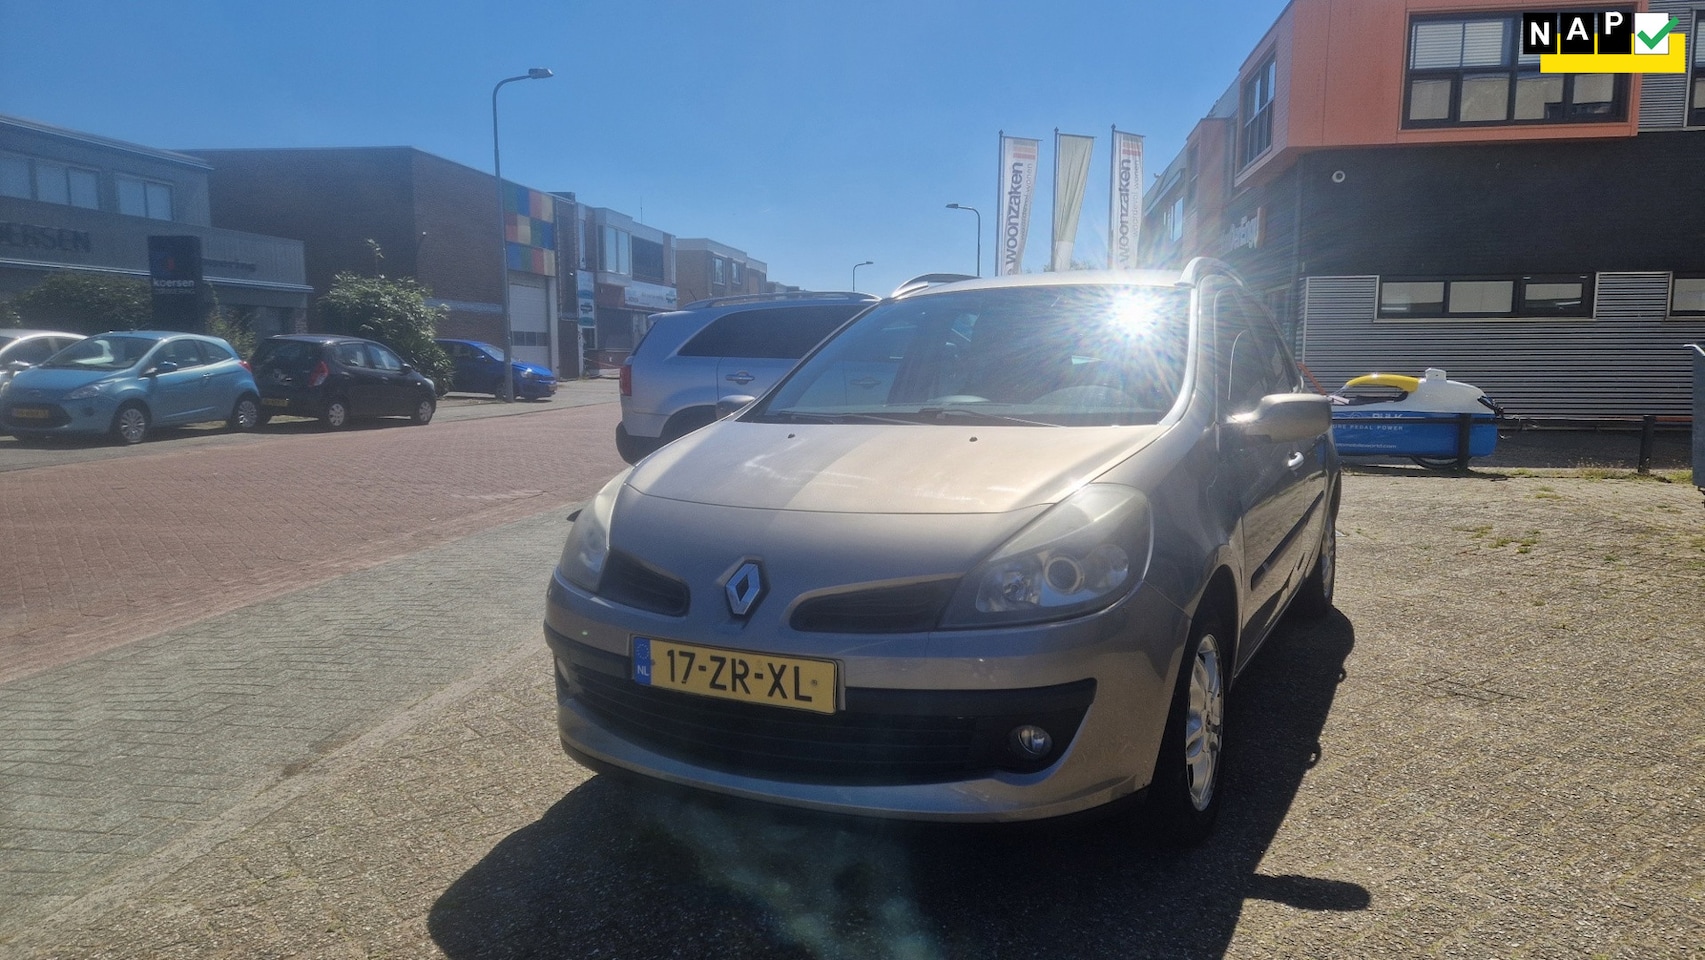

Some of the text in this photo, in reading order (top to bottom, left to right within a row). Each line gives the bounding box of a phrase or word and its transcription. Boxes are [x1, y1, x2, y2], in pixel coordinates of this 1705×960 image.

[1006, 162, 1023, 265] woonzaken
[1118, 159, 1131, 263] woonzaken
[153, 277, 195, 288] koersen
[637, 665, 649, 677] NL
[667, 649, 812, 703] 17-ZR-XL
